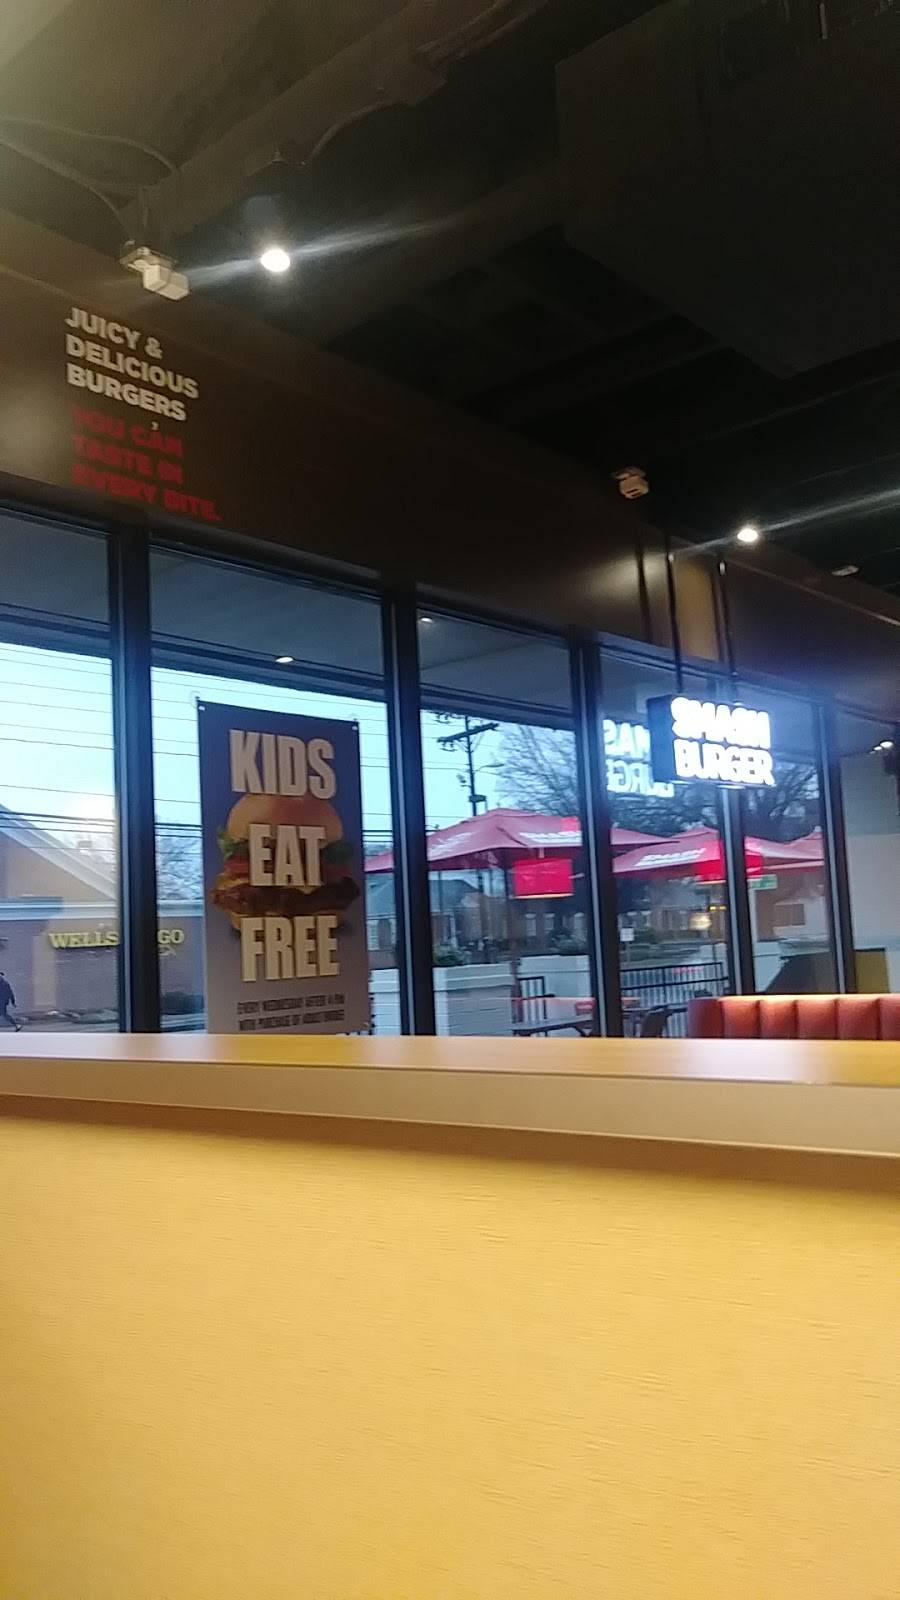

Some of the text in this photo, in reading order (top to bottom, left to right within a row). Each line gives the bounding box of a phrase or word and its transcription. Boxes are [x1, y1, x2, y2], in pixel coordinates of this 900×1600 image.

[65, 307, 163, 359] JUICY &
[65, 334, 199, 399] DELICIOUS
[67, 362, 187, 421] BURGERS
[72, 407, 182, 457] YOU CAN
[72, 435, 153, 476] TASTE
[72, 464, 157, 503] EVERY
[671, 697, 771, 749] SMASH
[229, 729, 338, 799] KIDS
[674, 739, 776, 786] BURGER
[249, 823, 326, 887] EAT
[48, 931, 121, 949] WELLS
[241, 915, 341, 983] FREE
